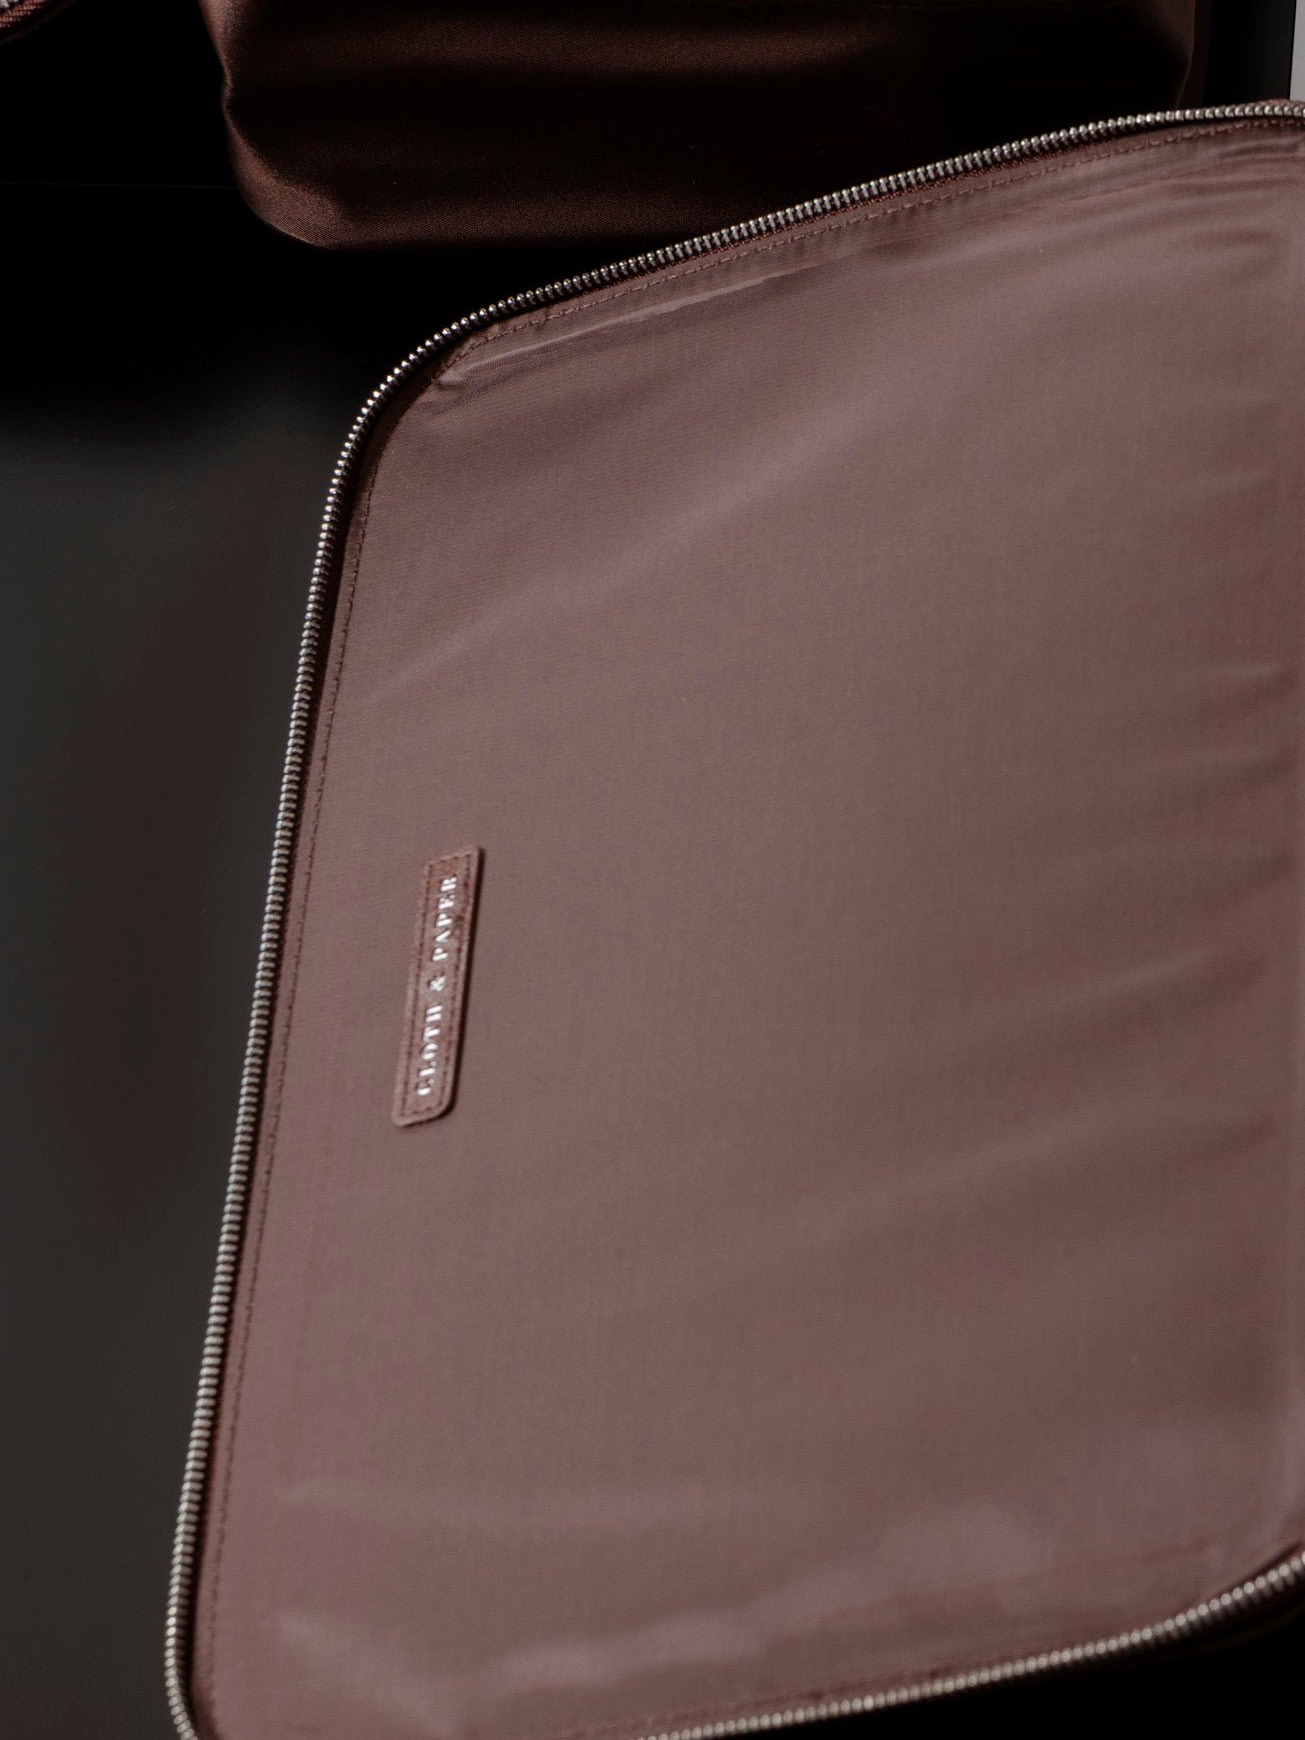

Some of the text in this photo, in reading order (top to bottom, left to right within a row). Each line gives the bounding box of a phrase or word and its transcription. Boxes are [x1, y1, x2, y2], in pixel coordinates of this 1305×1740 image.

[415, 873, 459, 1097] CLOTH & PAPER
